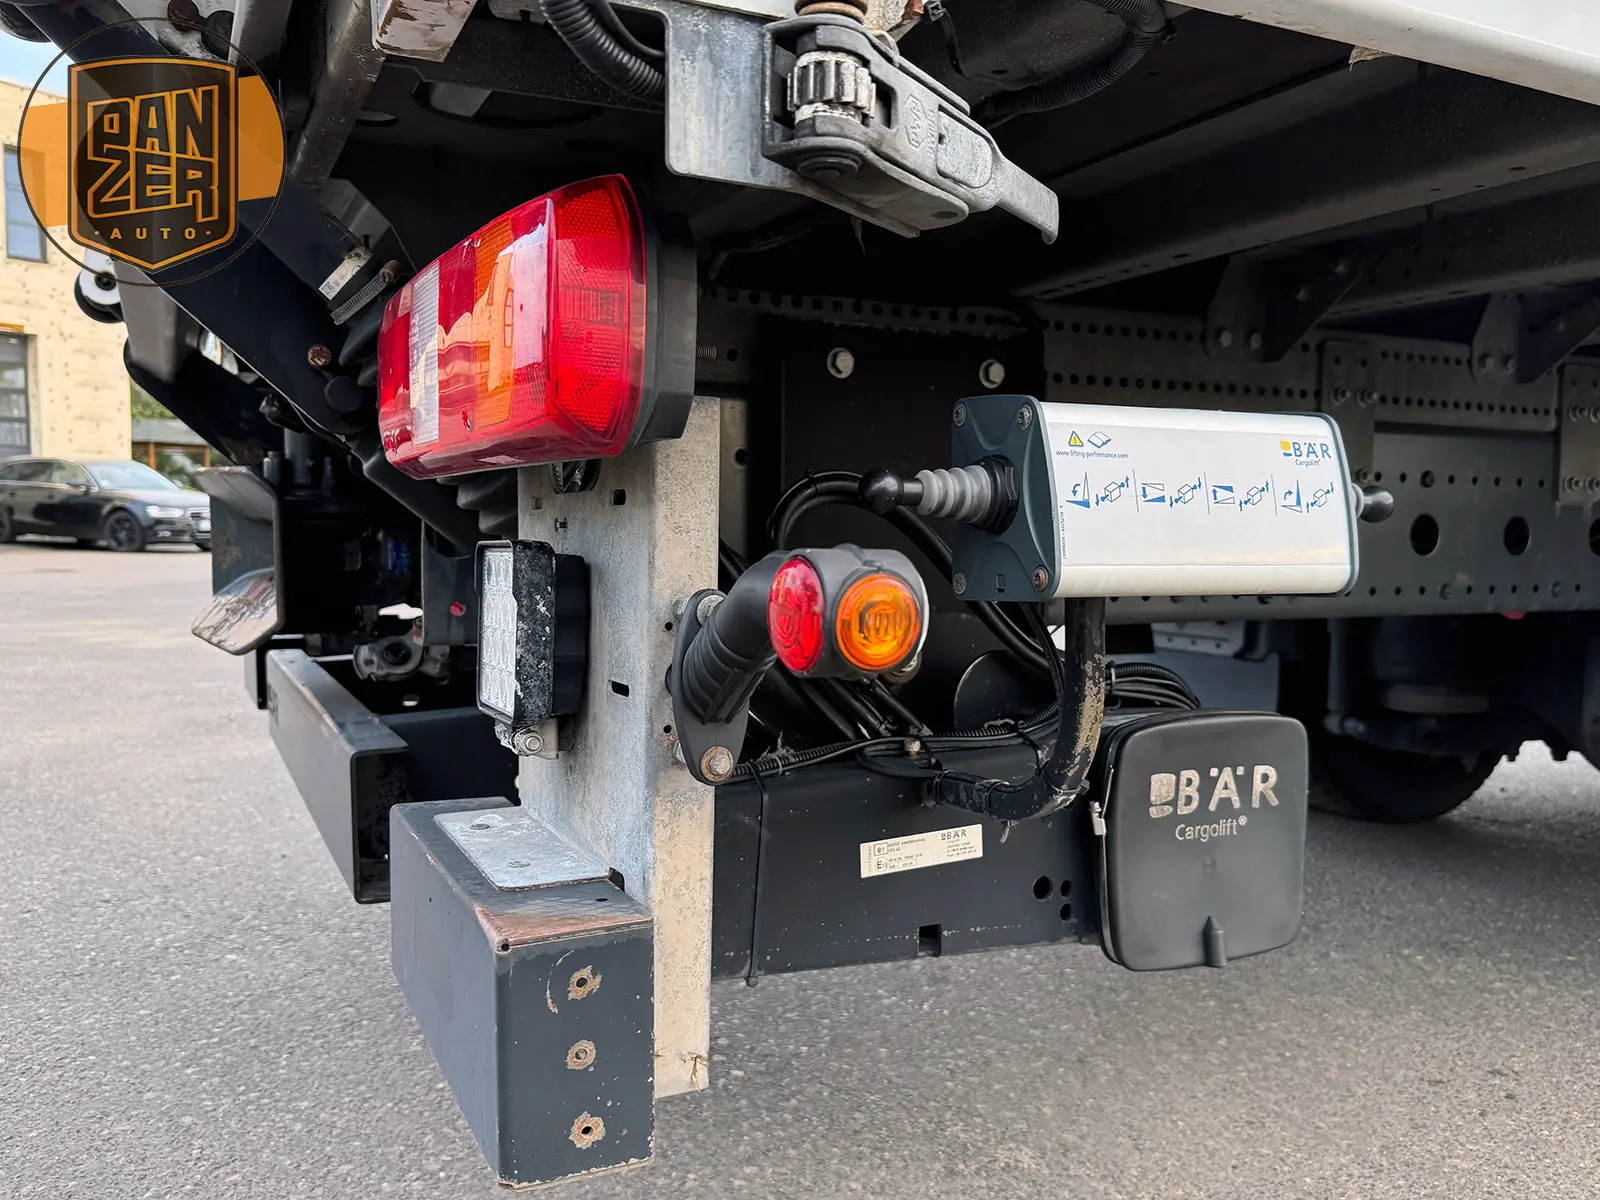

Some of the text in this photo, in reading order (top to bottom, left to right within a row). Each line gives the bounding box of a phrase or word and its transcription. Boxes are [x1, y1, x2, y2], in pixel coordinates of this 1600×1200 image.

[1056, 450, 1128, 459] www.lifting-performance.com
[1292, 441, 1332, 459] BÄR
[1177, 765, 1279, 815] BÄR
[946, 829, 967, 840] BÄR
